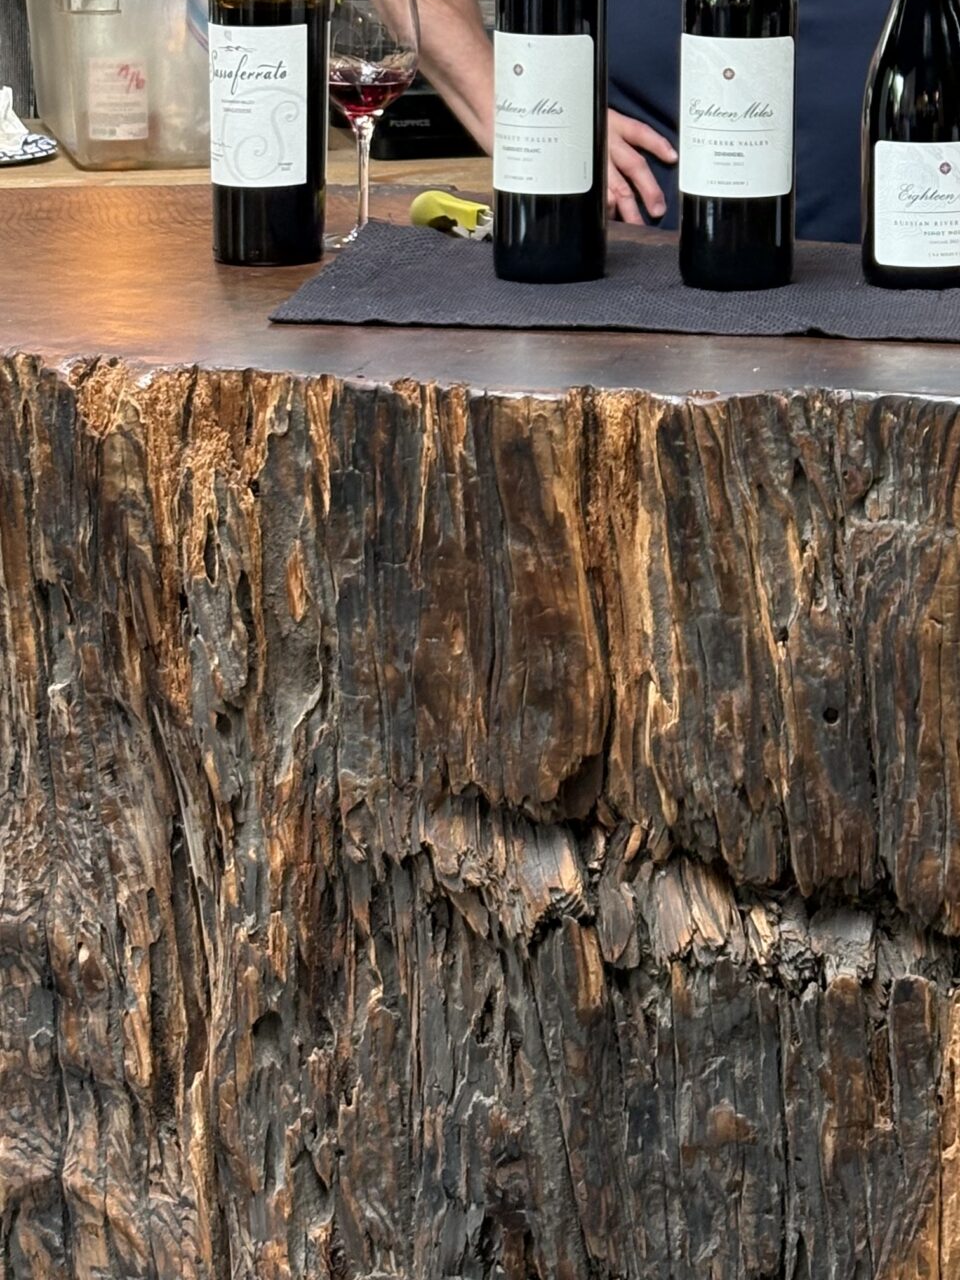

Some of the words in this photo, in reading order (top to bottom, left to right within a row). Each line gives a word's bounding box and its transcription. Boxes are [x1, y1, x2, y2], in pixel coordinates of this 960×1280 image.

[527, 97, 565, 117] Miles
[688, 98, 738, 122] Eighteen
[736, 100, 775, 120] Miles
[524, 135, 559, 143] VALLEY
[738, 139, 769, 147] VALLEY
[897, 183, 954, 207] Eighteen
[893, 219, 930, 227] RUSSIAN
[933, 219, 959, 227] RIVER
